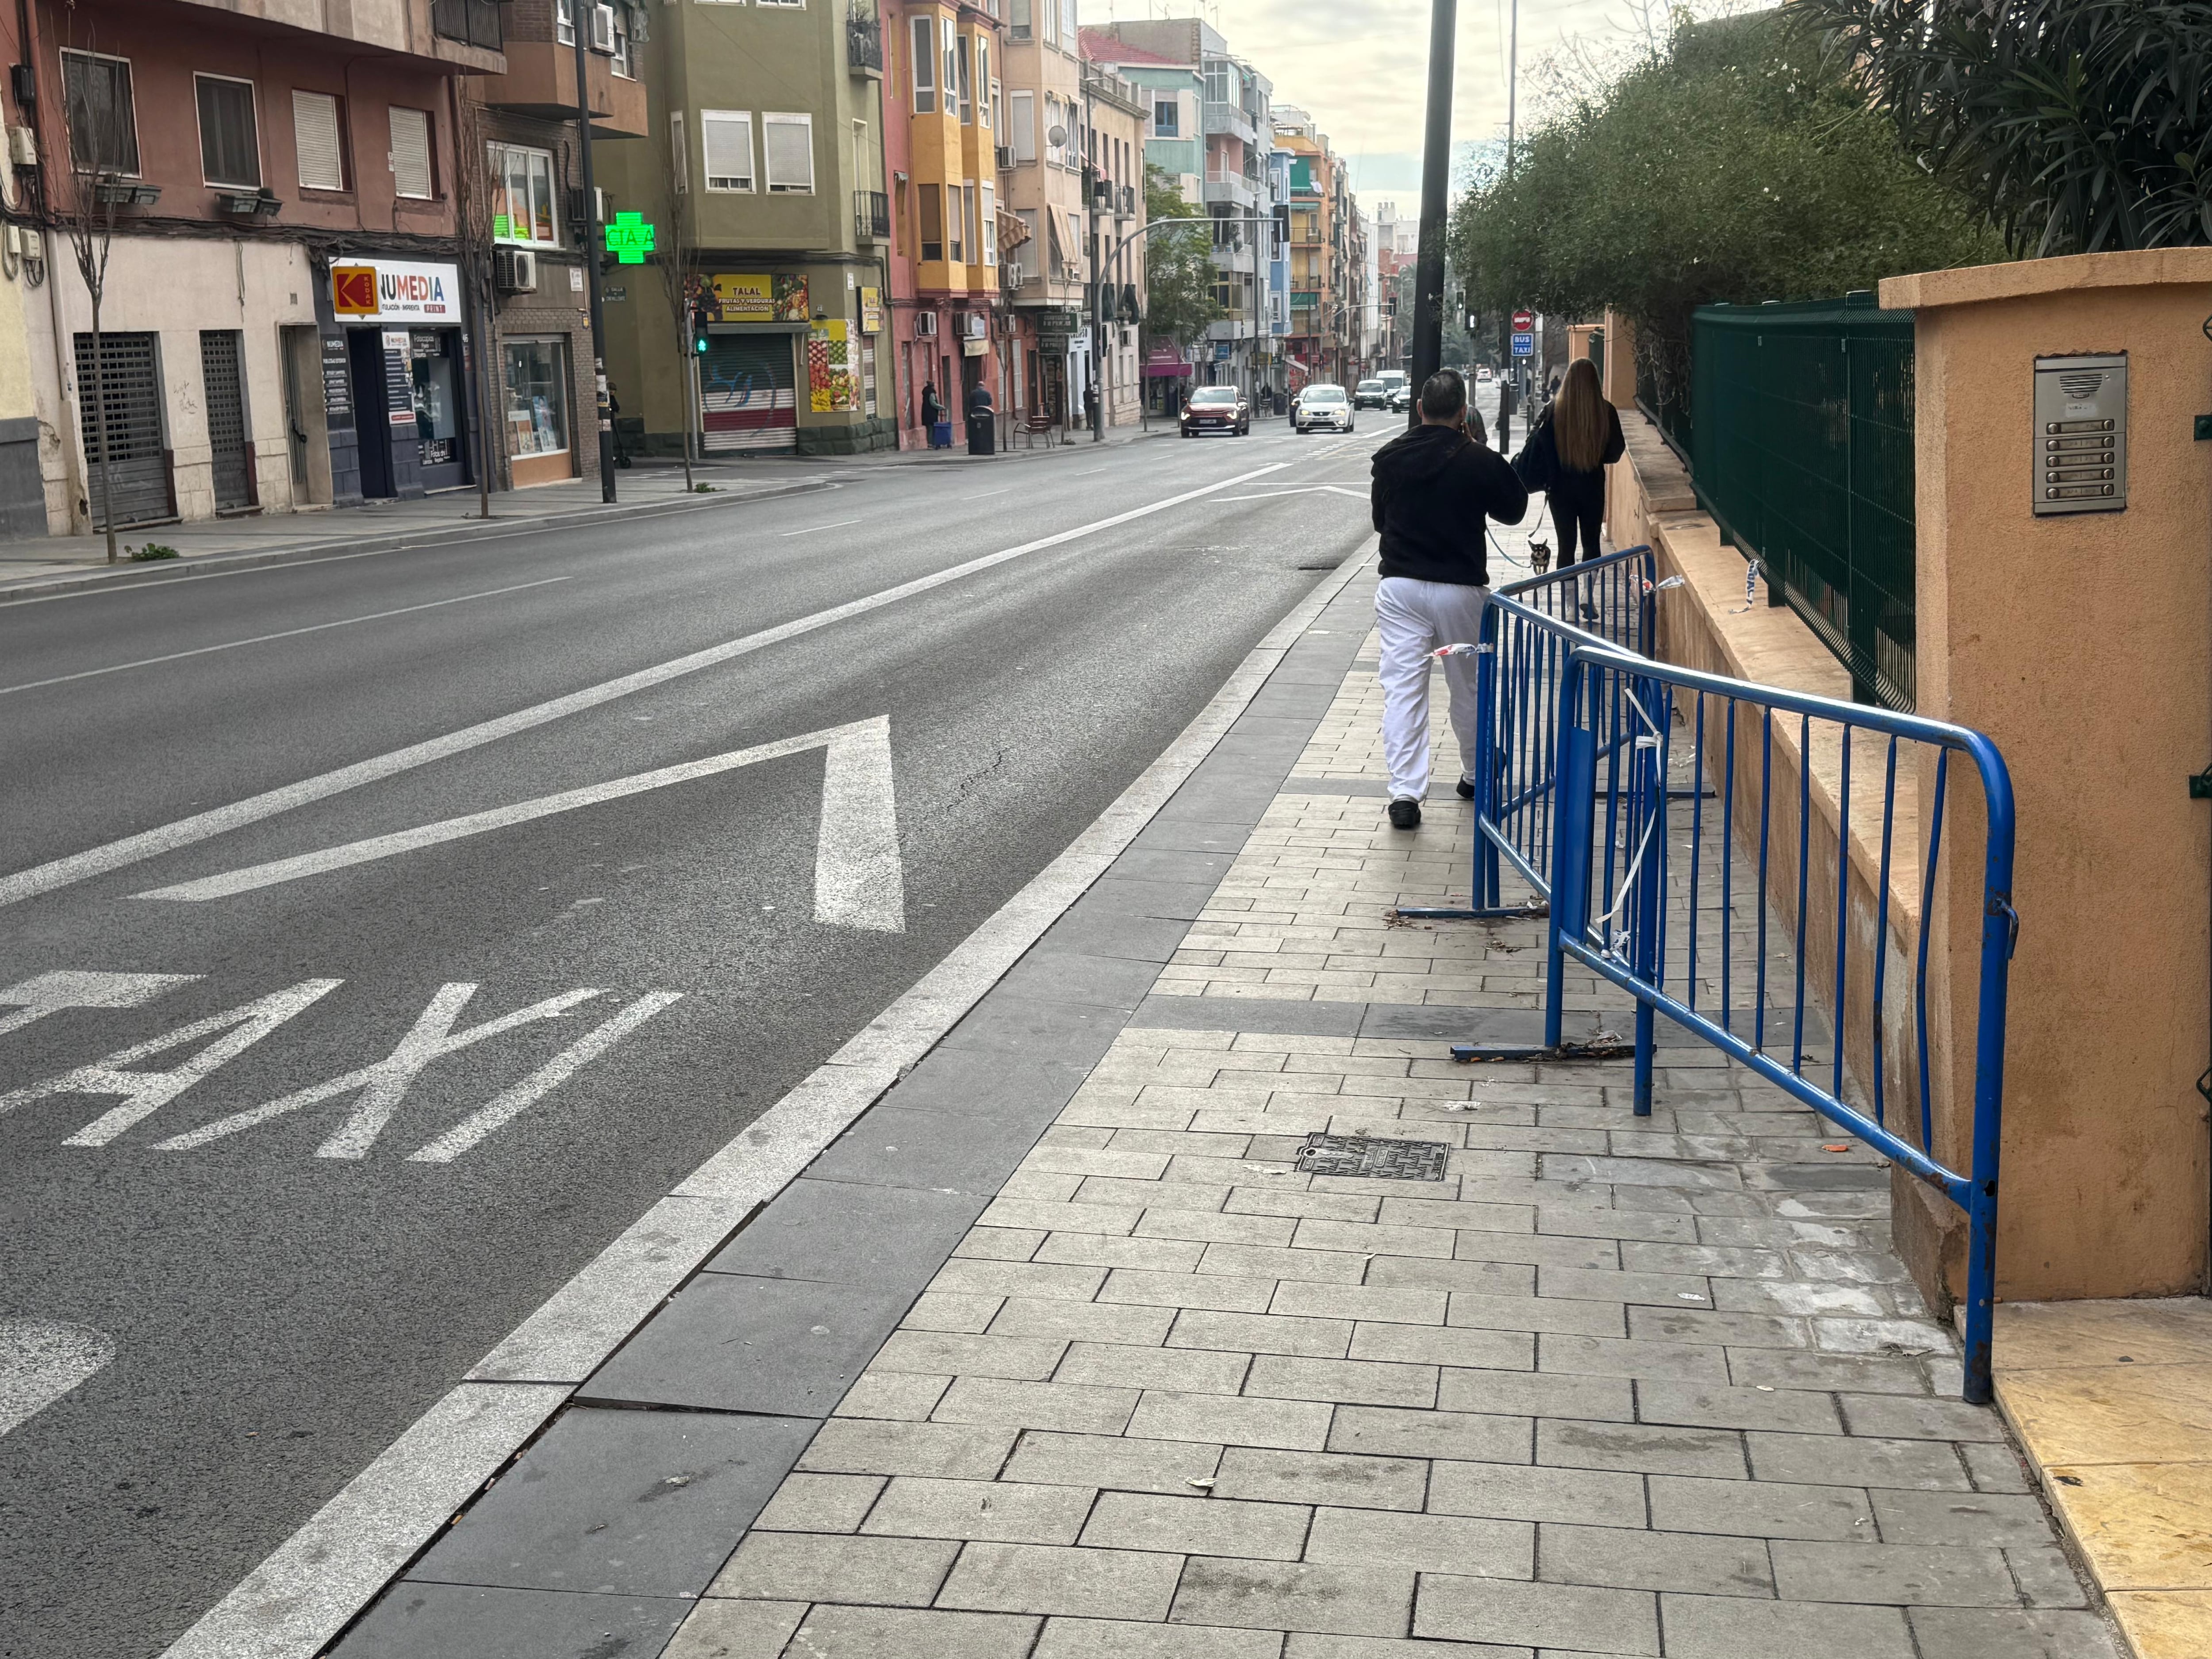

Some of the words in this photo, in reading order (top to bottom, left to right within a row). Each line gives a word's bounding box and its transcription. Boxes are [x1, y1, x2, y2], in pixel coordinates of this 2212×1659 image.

[733, 287, 761, 296] TALAL
[426, 304, 442, 313] PRINT
[0, 969, 684, 1163] TAXI
